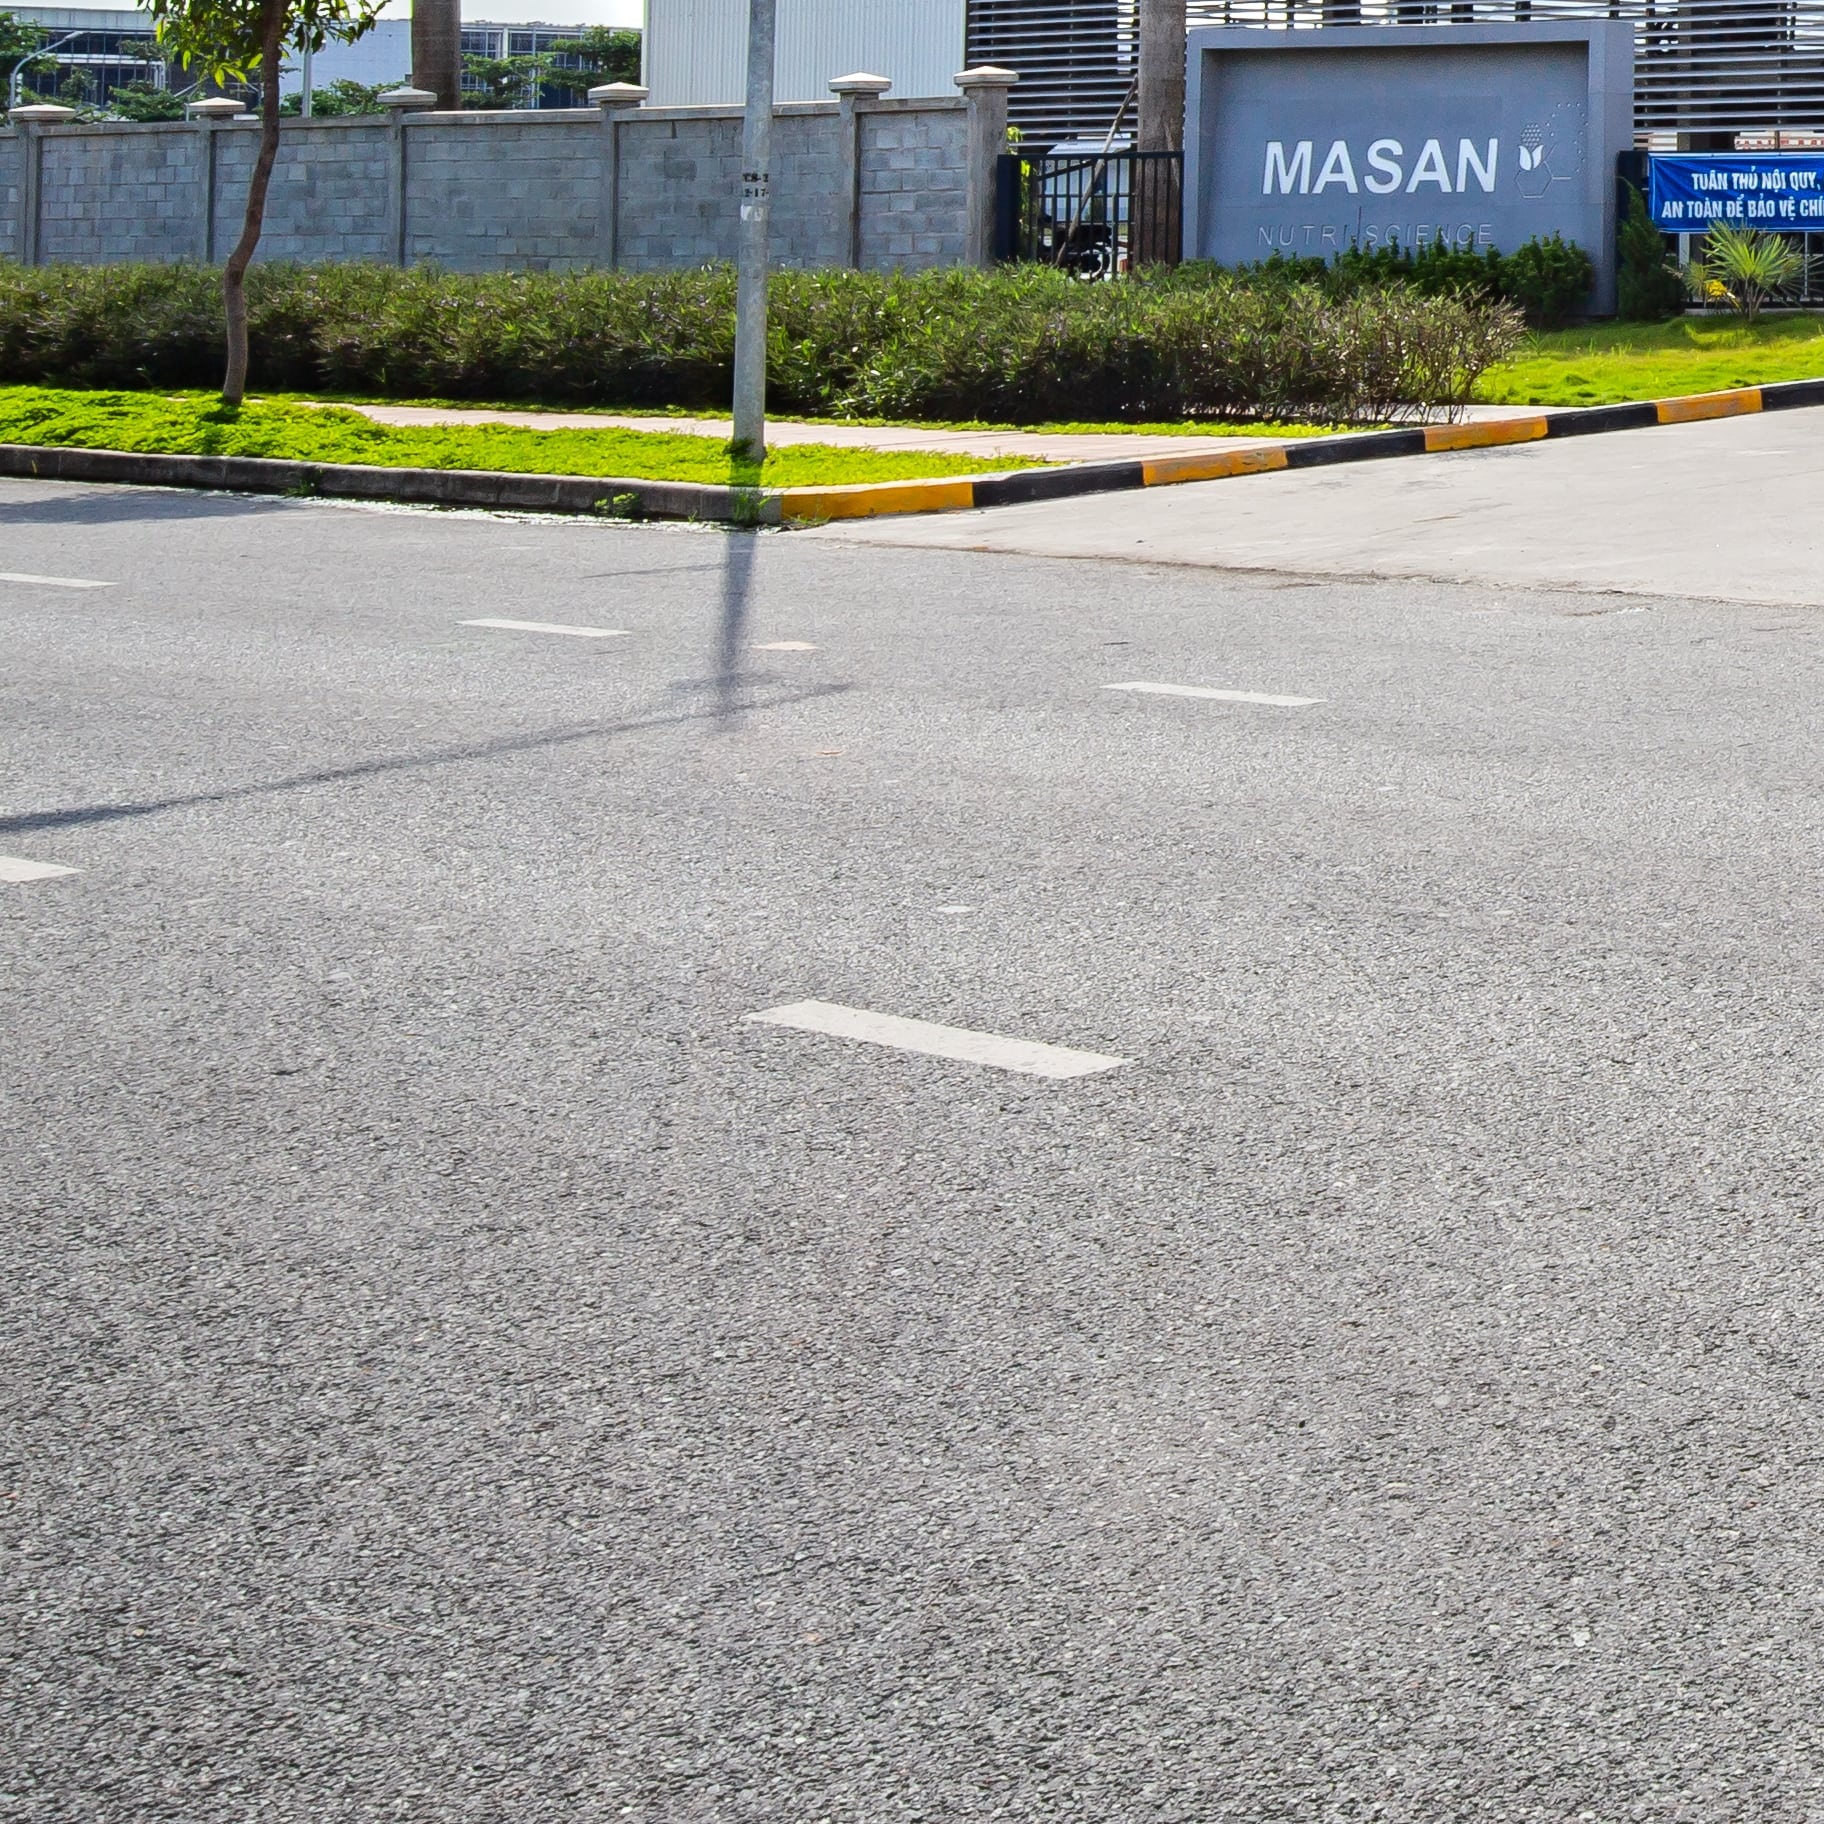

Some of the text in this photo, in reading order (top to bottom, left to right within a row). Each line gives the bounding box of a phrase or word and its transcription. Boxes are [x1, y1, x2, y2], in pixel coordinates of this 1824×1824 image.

[1261, 138, 1498, 195] MASAN
[1692, 170, 1728, 190] TUÂN
[1732, 166, 1758, 190] THỦ
[1762, 169, 1786, 192] NỘI
[1790, 171, 1821, 191] QUY,
[1662, 200, 1684, 218] AN
[1686, 197, 1723, 218] TOÀN
[1726, 193, 1745, 218] ĐỂ
[1748, 193, 1775, 217] BẢO
[1779, 196, 1796, 221] VỆ
[1257, 224, 1348, 246] NUTRI
